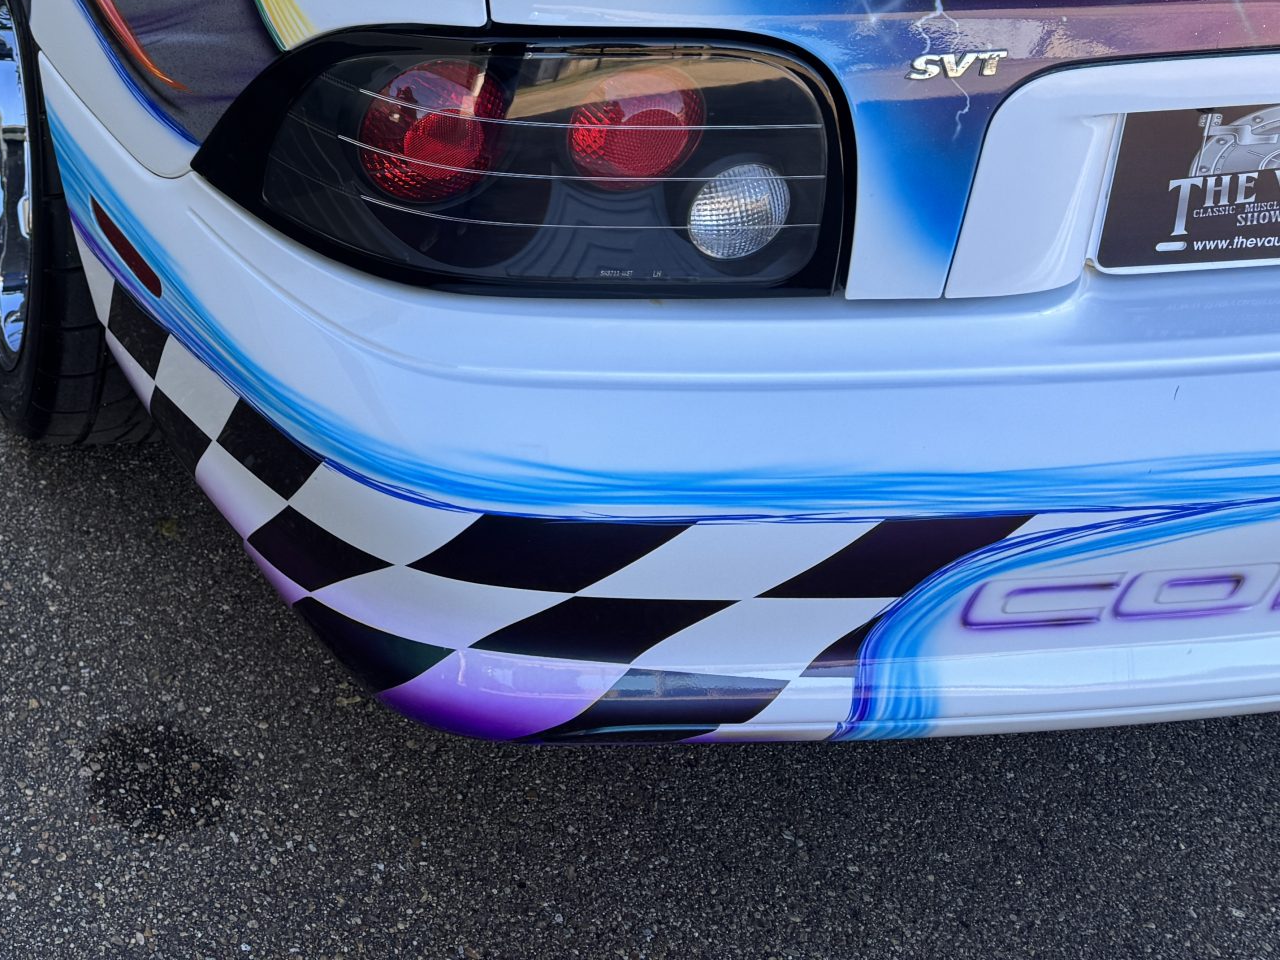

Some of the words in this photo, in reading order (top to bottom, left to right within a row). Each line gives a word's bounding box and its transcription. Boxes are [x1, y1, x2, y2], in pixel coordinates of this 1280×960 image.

[904, 49, 1008, 80] SVT
[1168, 172, 1258, 236] THE
[1193, 205, 1236, 218] CLASSIC
[961, 562, 1280, 629] CO
